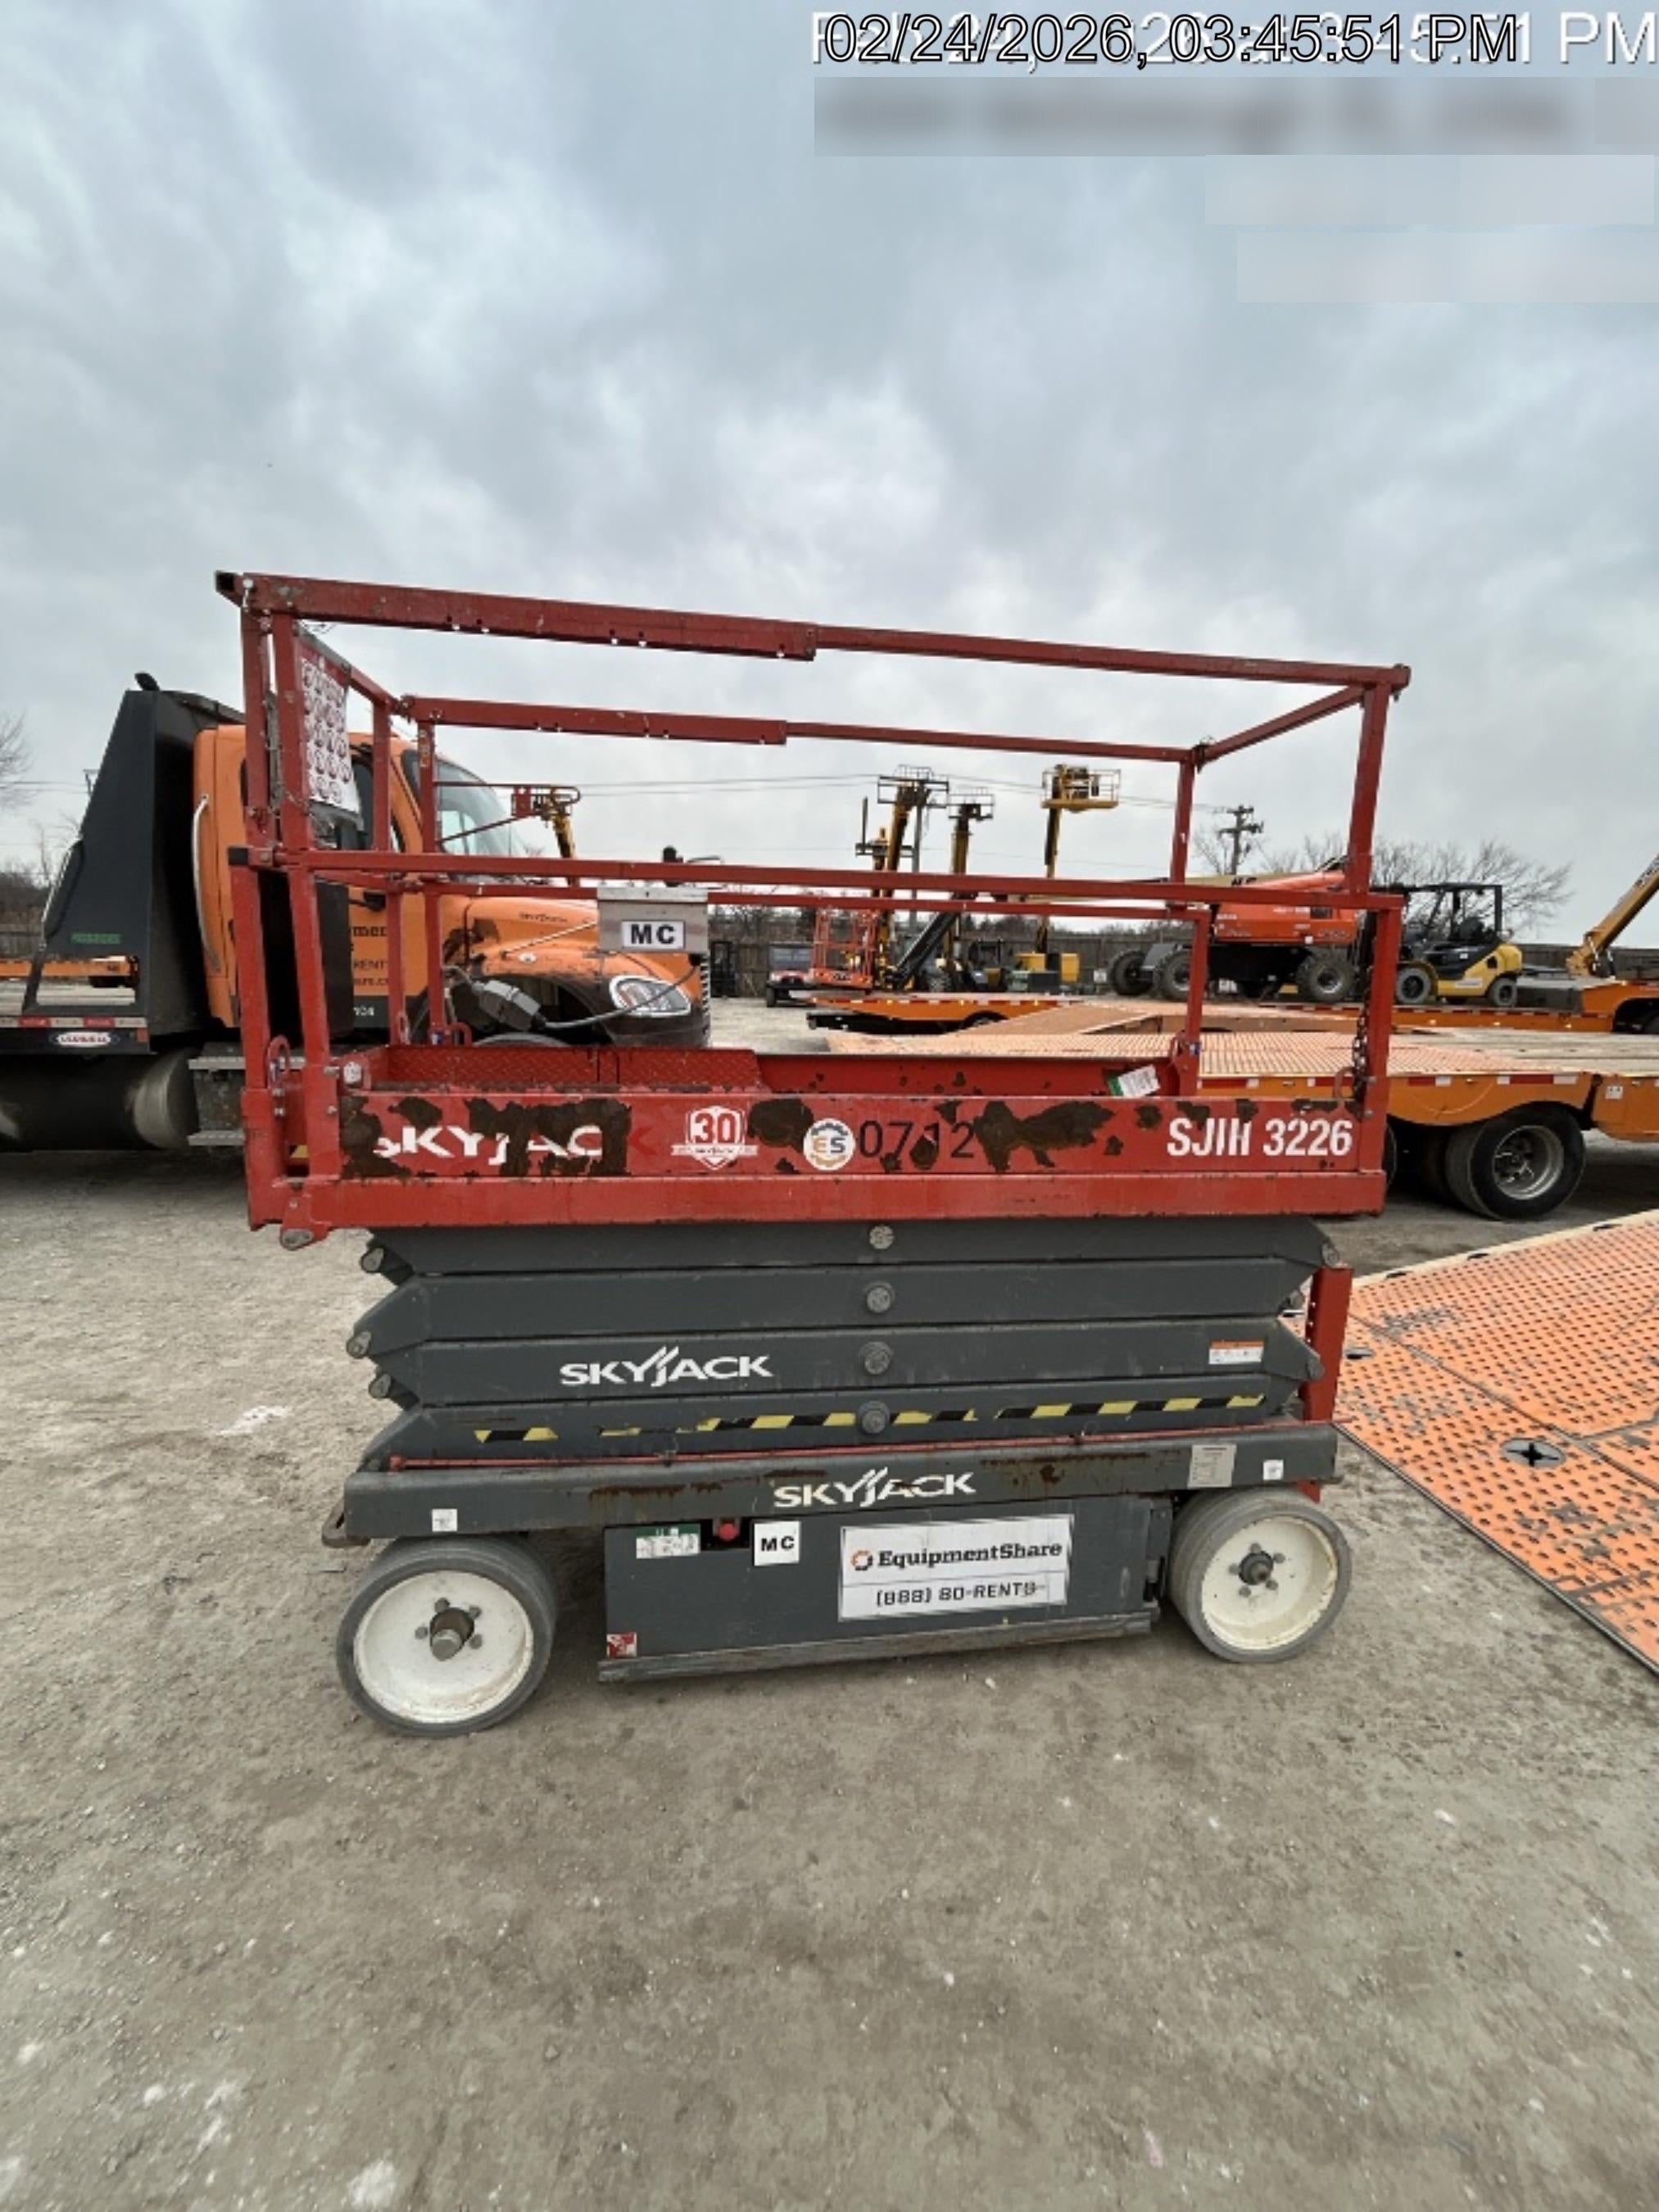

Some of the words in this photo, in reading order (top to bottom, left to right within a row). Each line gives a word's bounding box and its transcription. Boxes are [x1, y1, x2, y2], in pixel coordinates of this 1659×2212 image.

[630, 923, 675, 945] MC
[694, 1113, 736, 1144] 30
[859, 1120, 975, 1159] 0712
[1262, 1118, 1353, 1157] 3226
[560, 1346, 774, 1387] SKYJACK
[773, 1466, 977, 1507] SKYJACK
[760, 1536, 795, 1552] MC
[877, 1543, 1063, 1569] EquipmentShare
